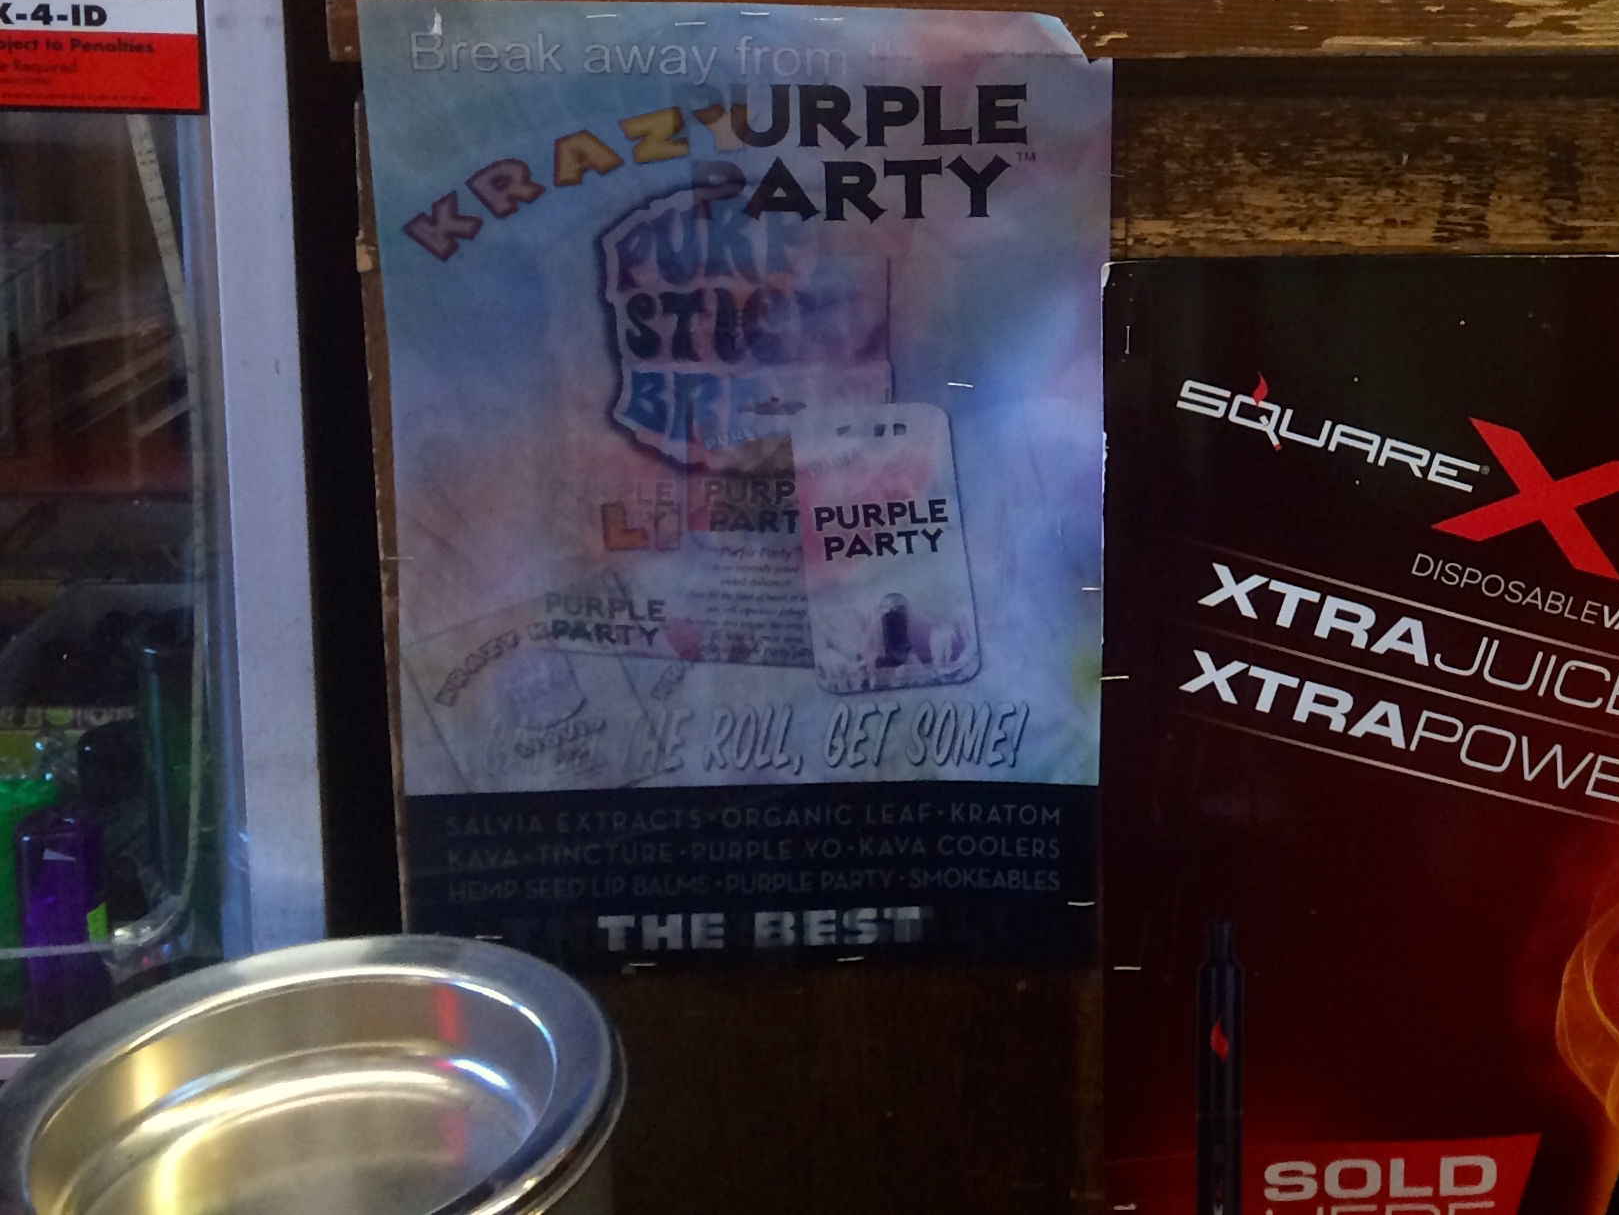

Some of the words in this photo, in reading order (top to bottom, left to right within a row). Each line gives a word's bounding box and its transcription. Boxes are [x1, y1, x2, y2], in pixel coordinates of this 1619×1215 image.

[410, 31, 564, 75] Break
[584, 37, 718, 84] away
[738, 35, 848, 77] from
[690, 155, 1012, 223] PARTY
[1176, 372, 1481, 493] SQUARE
[813, 498, 949, 531] PURPLE
[822, 529, 948, 562] PARTY
[703, 703, 802, 776] ROLL,
[824, 701, 903, 769] GET
[906, 701, 1031, 769] SOME!
[446, 814, 542, 837] SALVIA
[937, 835, 1061, 859] COOLERS
[909, 869, 1061, 891] SMOKEABLES
[598, 914, 726, 952] THE
[753, 906, 932, 946] BEST
[1263, 1155, 1498, 1201] SOLD
